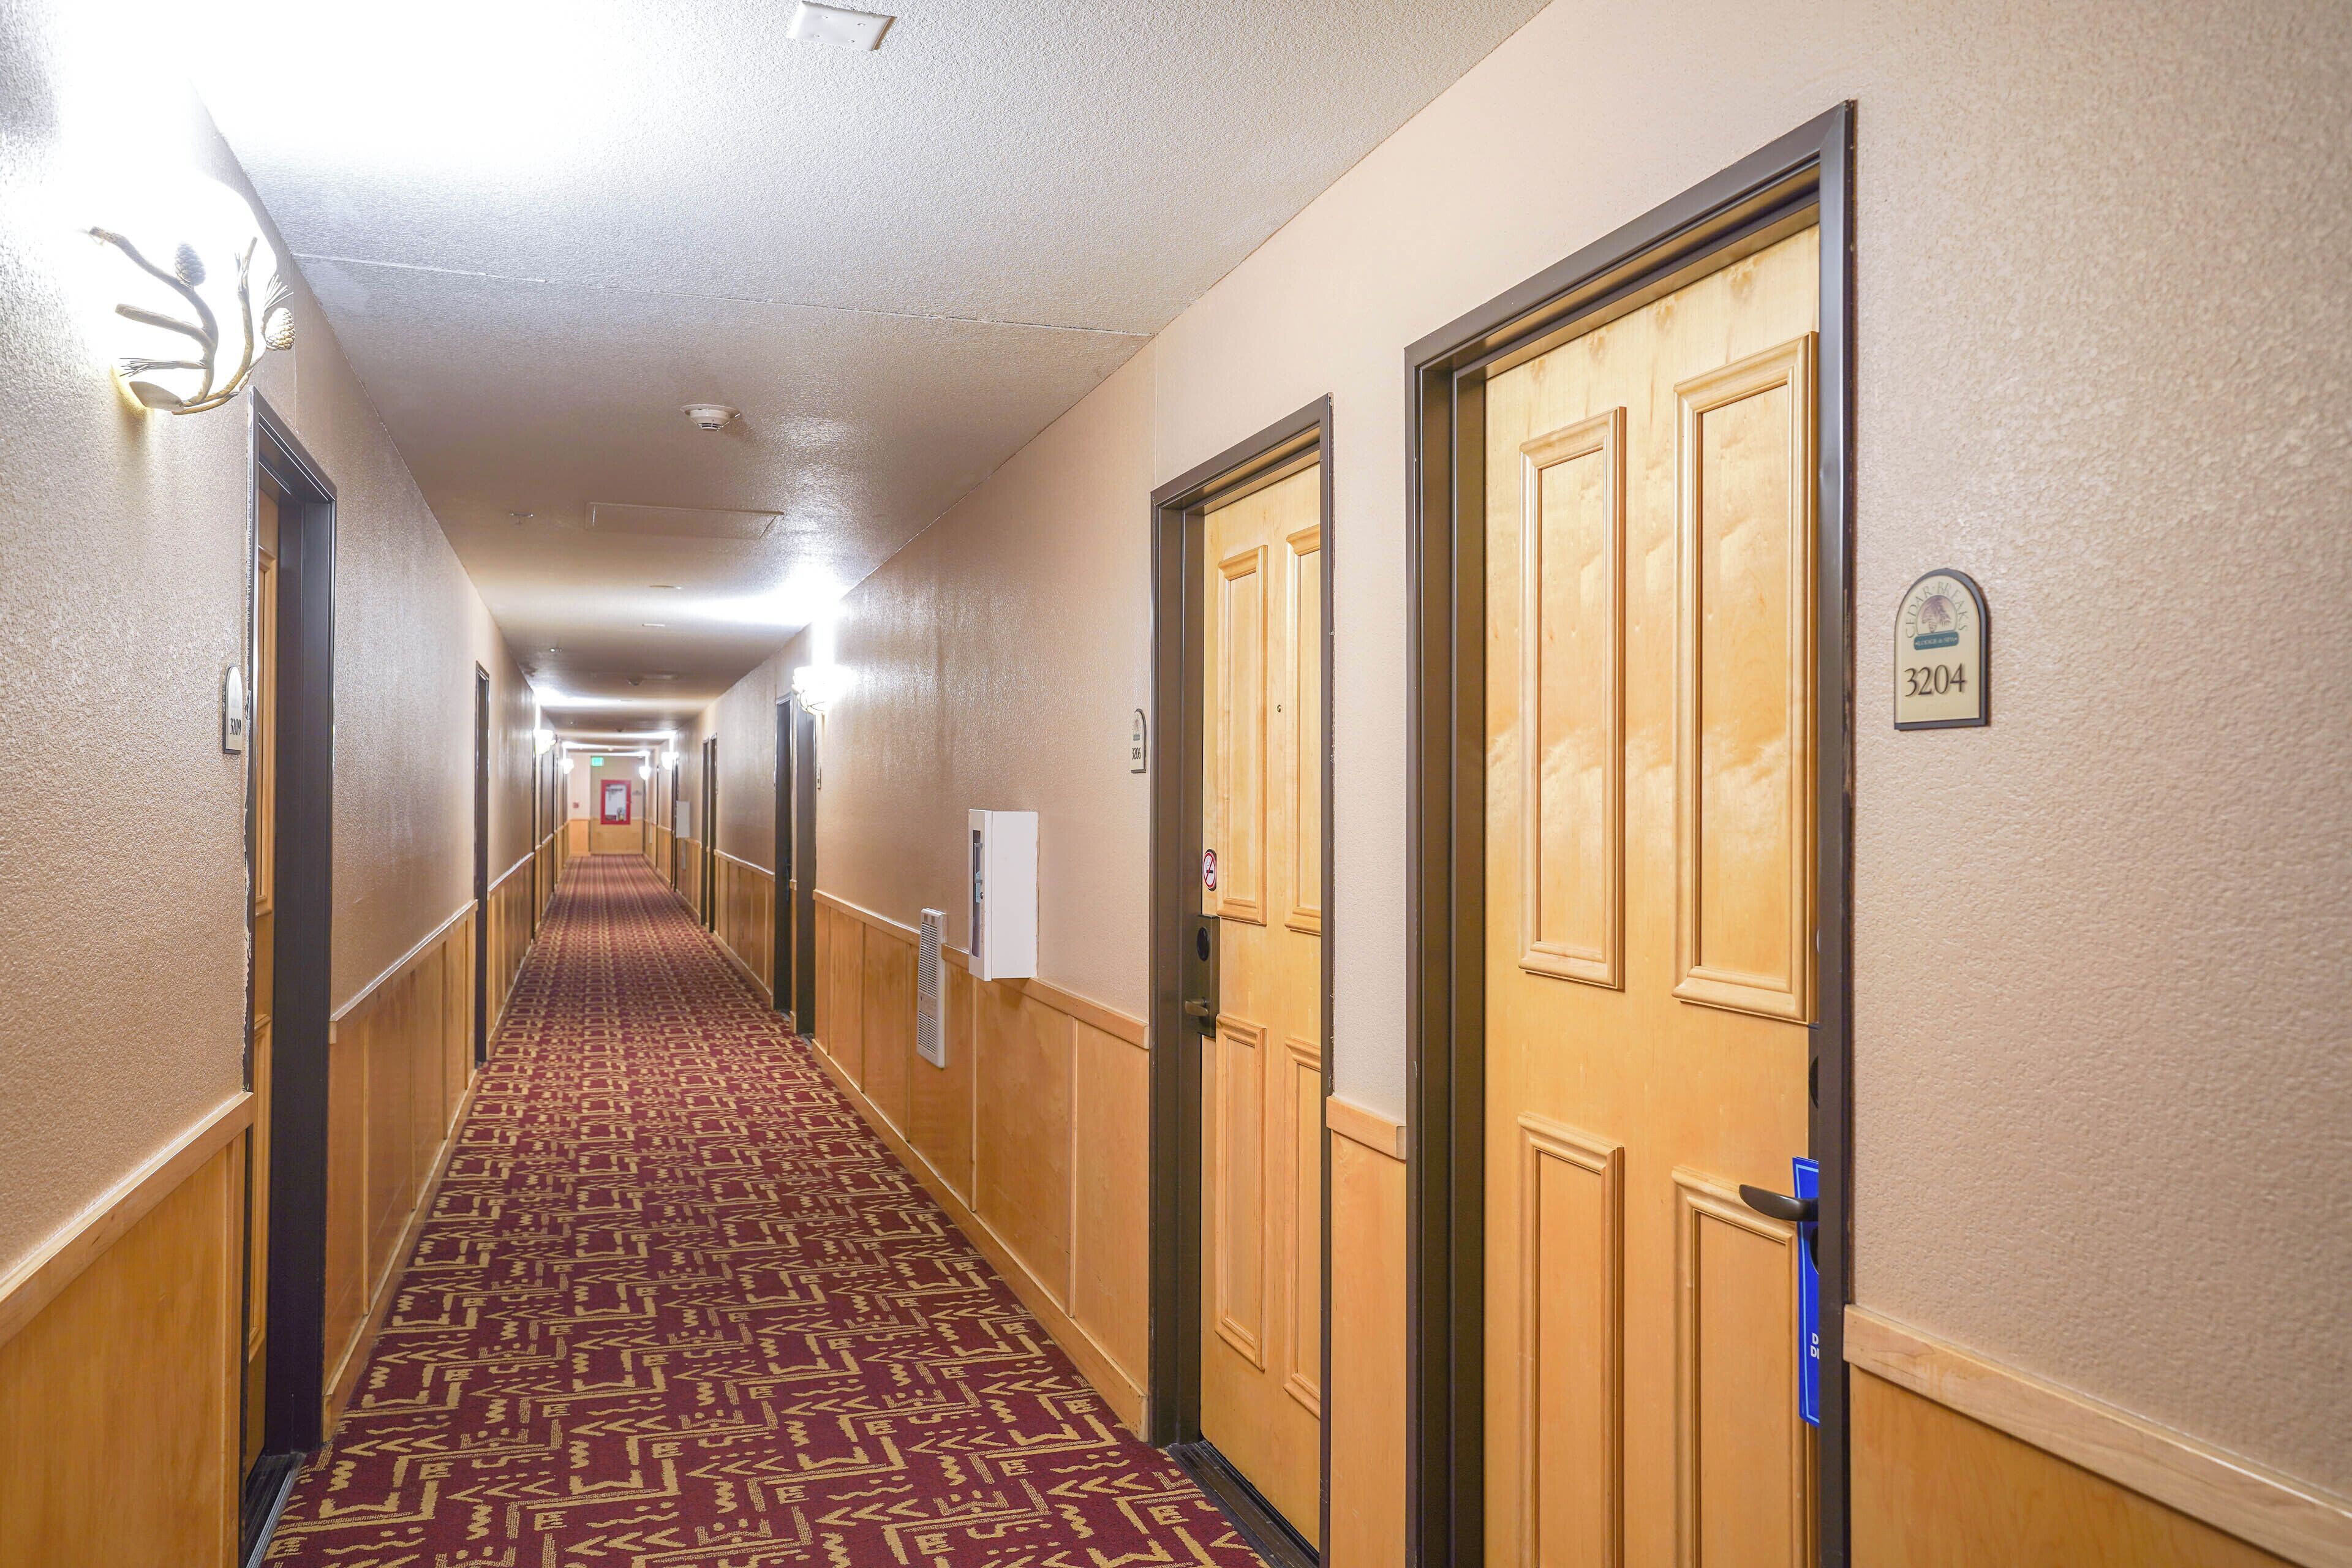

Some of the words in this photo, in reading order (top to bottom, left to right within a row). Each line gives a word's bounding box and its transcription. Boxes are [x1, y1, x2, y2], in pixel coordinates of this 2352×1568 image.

[1905, 586, 1932, 638] CEDAR
[1904, 663, 1967, 698] 3204
[230, 717, 242, 736] 3209
